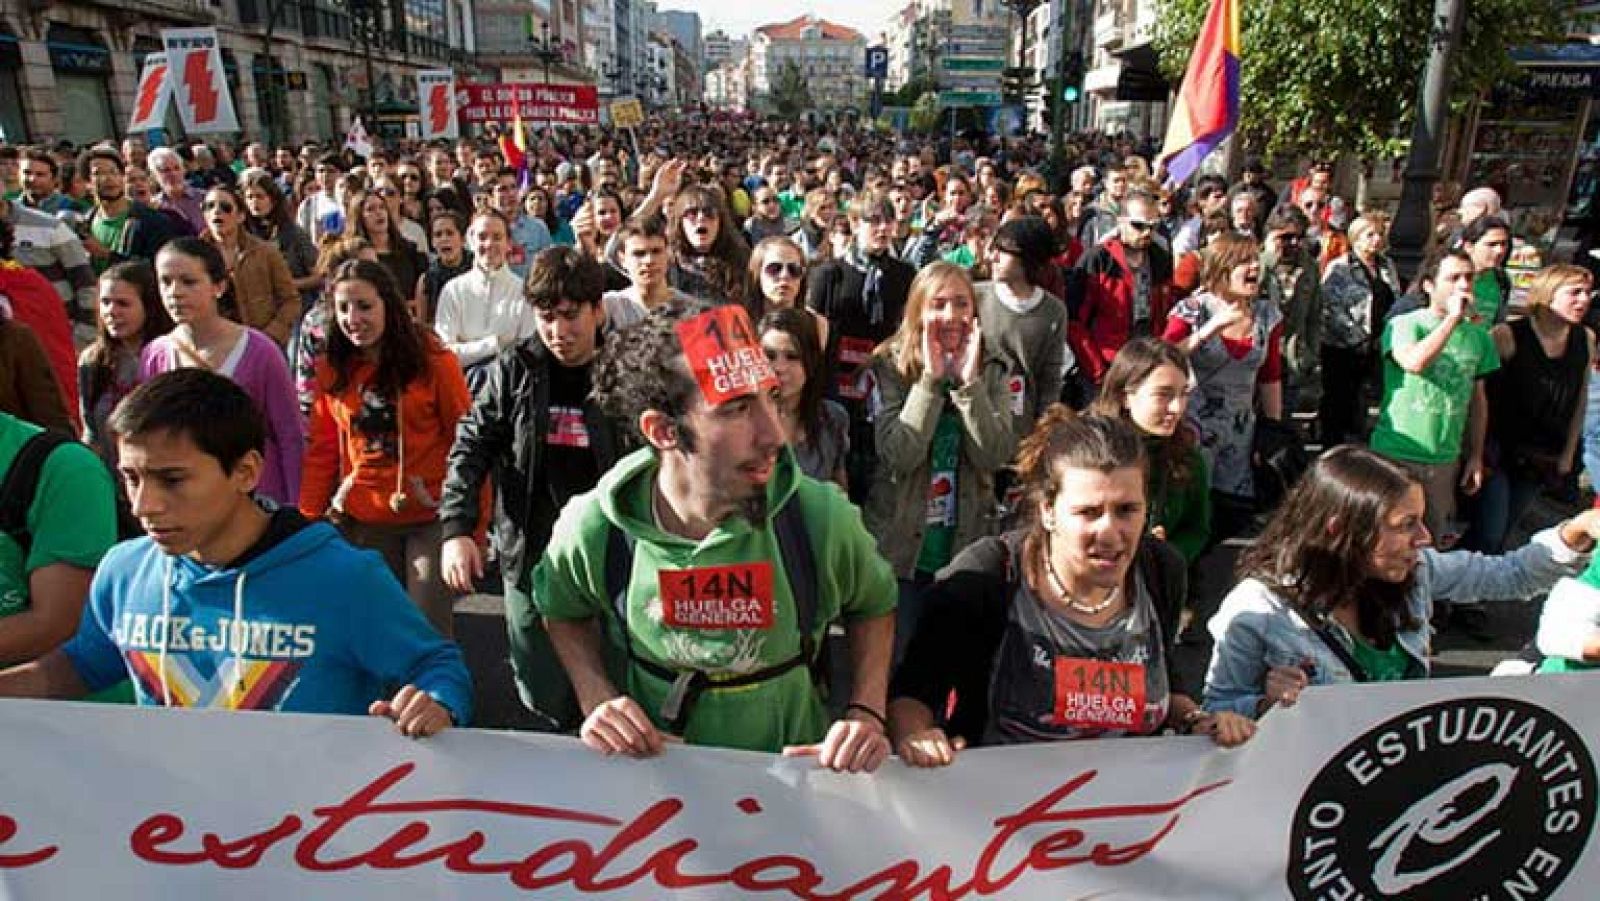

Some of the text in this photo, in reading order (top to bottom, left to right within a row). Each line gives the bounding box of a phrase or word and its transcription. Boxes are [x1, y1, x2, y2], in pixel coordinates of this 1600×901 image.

[871, 52, 884, 68] P
[681, 569, 752, 599] 14N
[674, 598, 762, 614] HUELGA
[674, 611, 762, 625] GENERAL
[1074, 665, 1132, 695] 14N
[1065, 691, 1136, 713] HUELGA
[1063, 707, 1133, 725] GENERAL
[1345, 706, 1584, 835] ESTUDIANTES
[130, 761, 1233, 901] estudiantes
